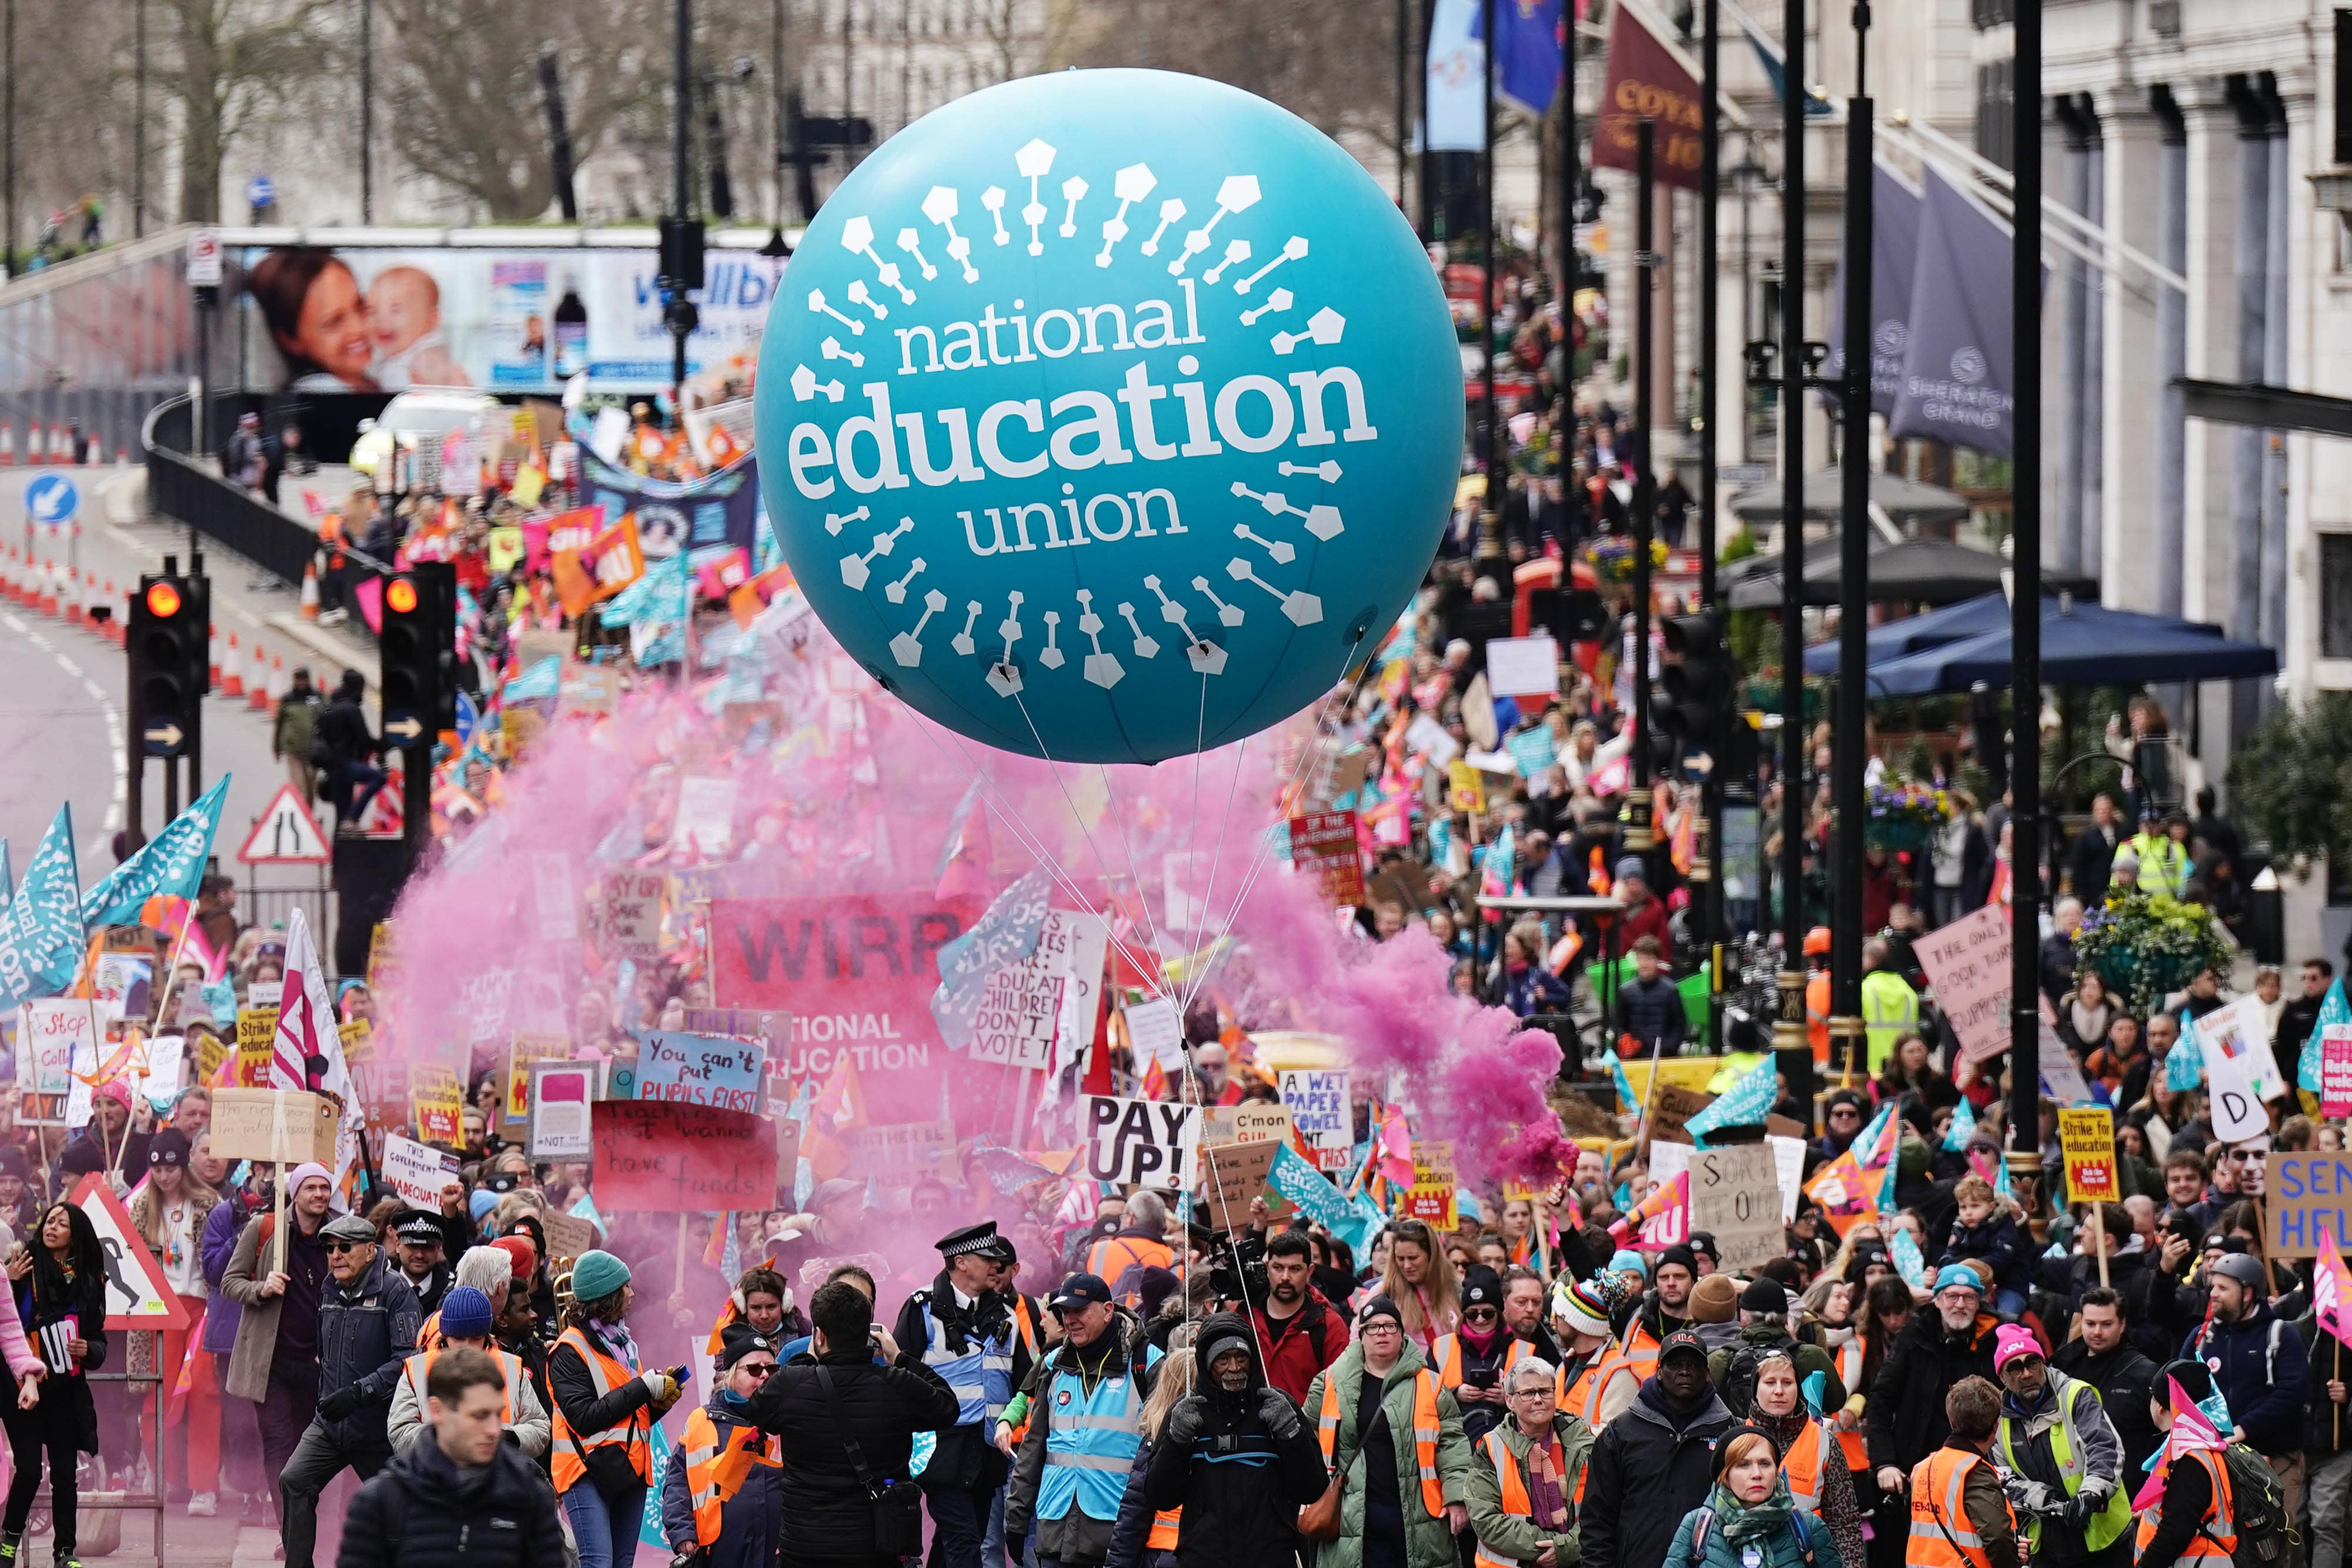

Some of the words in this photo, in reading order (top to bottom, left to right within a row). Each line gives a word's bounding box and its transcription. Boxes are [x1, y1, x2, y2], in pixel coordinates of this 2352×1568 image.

[895, 278, 1205, 376] national
[789, 355, 1378, 500] education
[957, 483, 1188, 556] union
[45, 1013, 87, 1037] Stop
[240, 1021, 271, 1037] Strike
[791, 1012, 901, 1042] TIONAL
[976, 1011, 1043, 1036] DON'T
[650, 1038, 687, 1062] You
[700, 1050, 755, 1074] can't
[976, 1031, 1030, 1058] VOTE
[678, 1065, 712, 1083] put
[1285, 1074, 1298, 1092] A
[1308, 1071, 1349, 1091] WET
[641, 1080, 707, 1106] PUPILS
[711, 1086, 757, 1114] FIRST
[1285, 1092, 1341, 1112] PAPER
[1087, 1097, 1194, 1146] PAY
[1237, 1114, 1285, 1128] C'mon
[2062, 1121, 2093, 1136] Strike
[2097, 1120, 2110, 1136] for
[406, 1144, 424, 1159] THIS
[2065, 1138, 2113, 1154] education
[390, 1152, 437, 1175] GOVERNMENT
[609, 1151, 667, 1173] have
[1088, 1138, 1184, 1184] UP!
[1703, 1148, 1770, 1187] SORT
[1414, 1171, 1454, 1184] ucation
[1671, 1333, 1698, 1345] FILA
[2003, 1341, 2024, 1354] UCU
